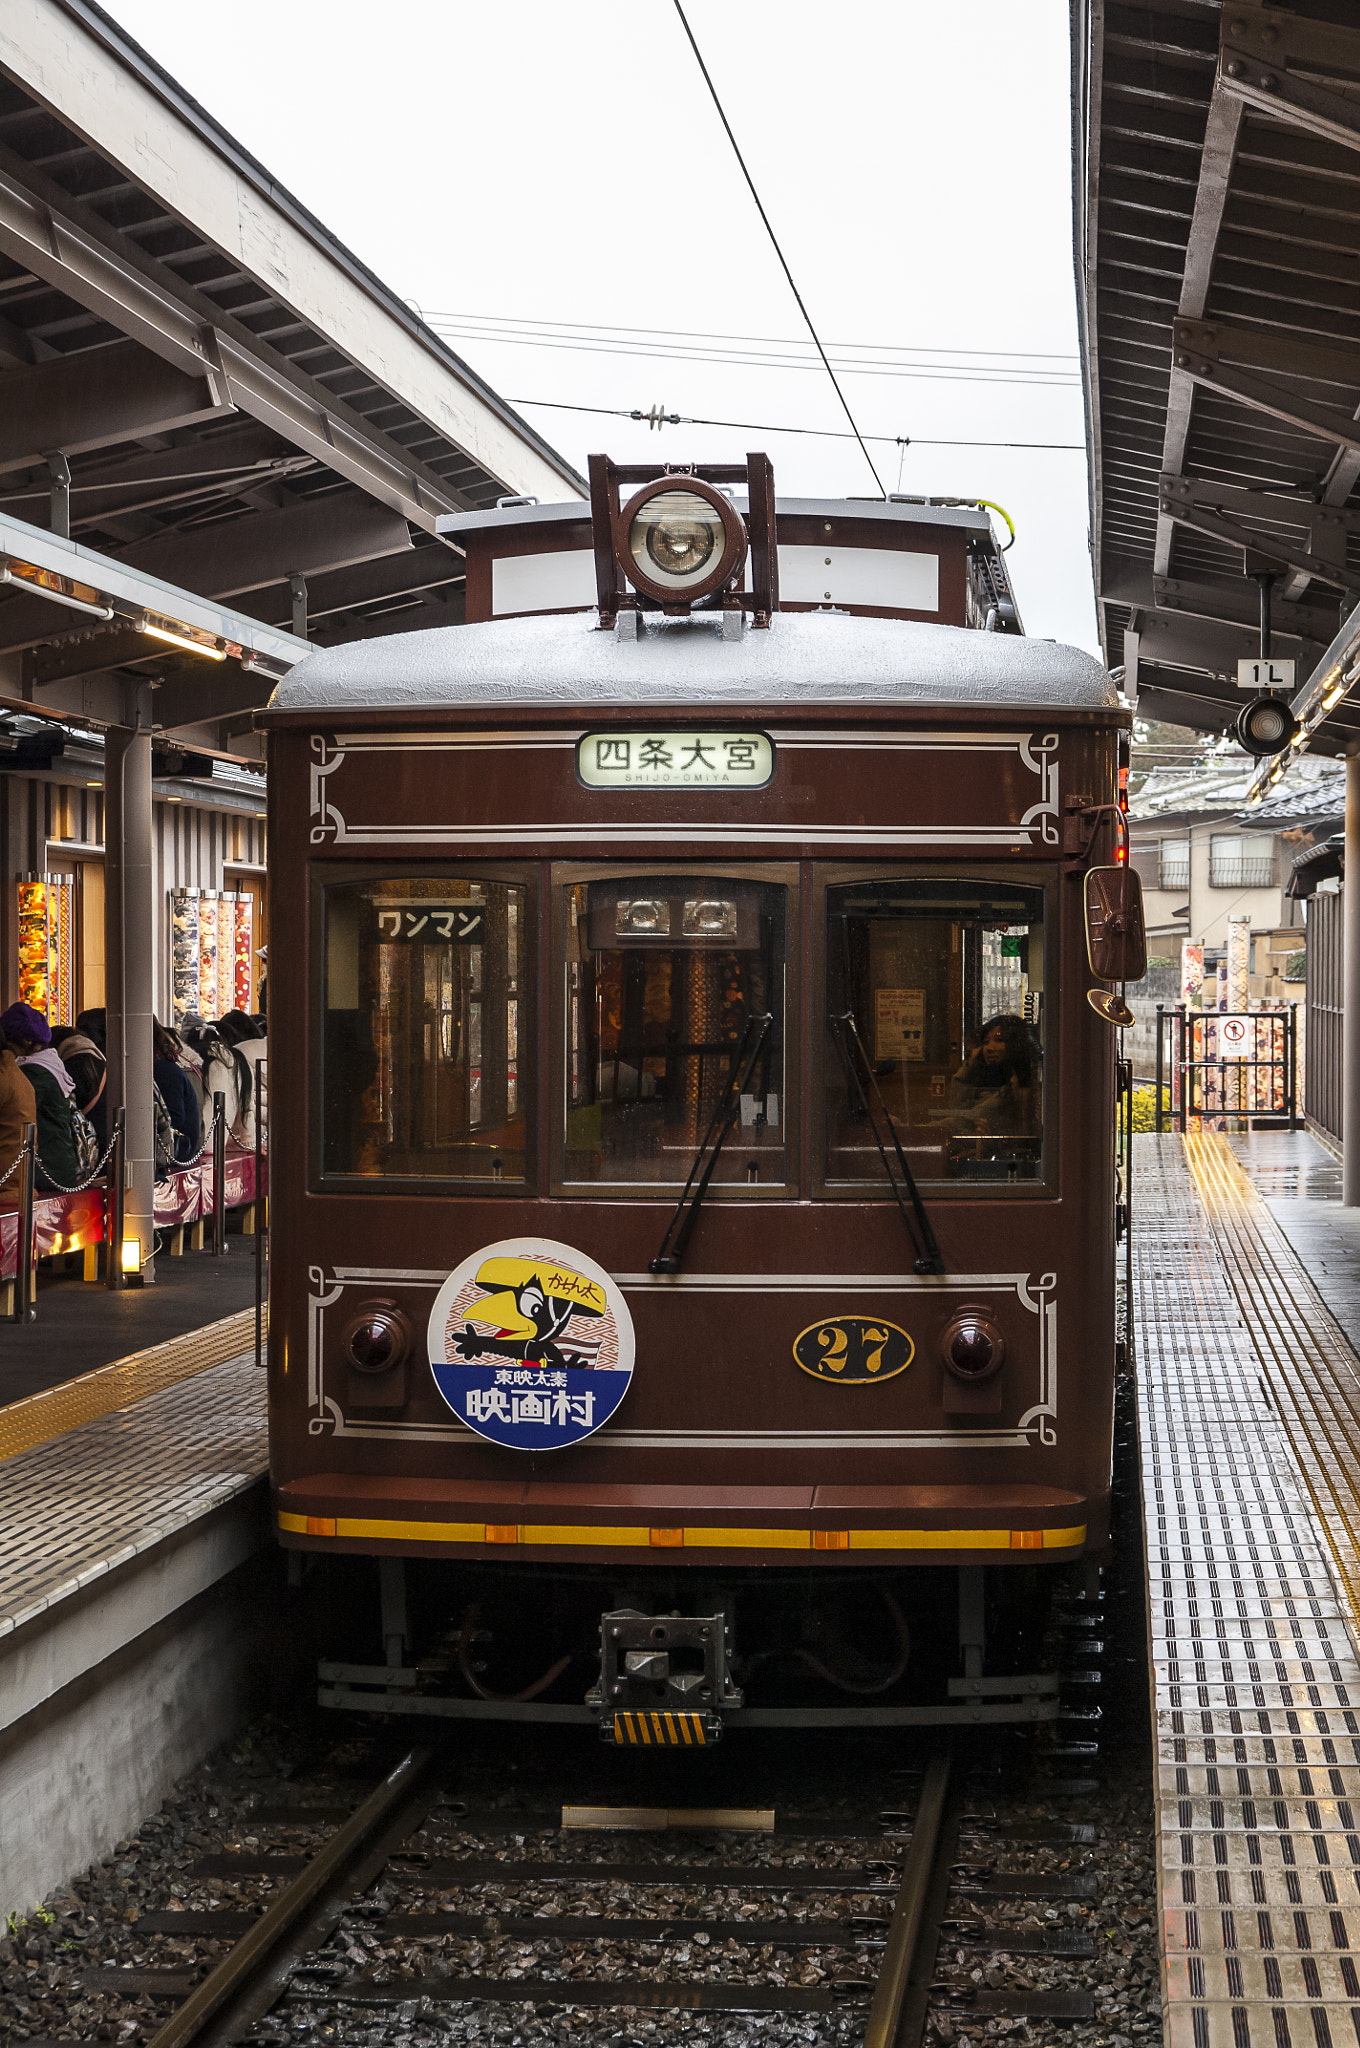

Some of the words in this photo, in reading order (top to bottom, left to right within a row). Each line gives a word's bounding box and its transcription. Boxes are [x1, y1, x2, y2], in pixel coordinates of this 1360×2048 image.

[596, 738, 759, 770] 四条大宮
[624, 773, 730, 782] SHIJO-OMIYA
[378, 912, 481, 937] ワンマン
[548, 1273, 601, 1304] かちん太
[817, 1327, 889, 1372] 27
[494, 1370, 568, 1387] 東映太秦
[466, 1388, 596, 1427] 映画村
